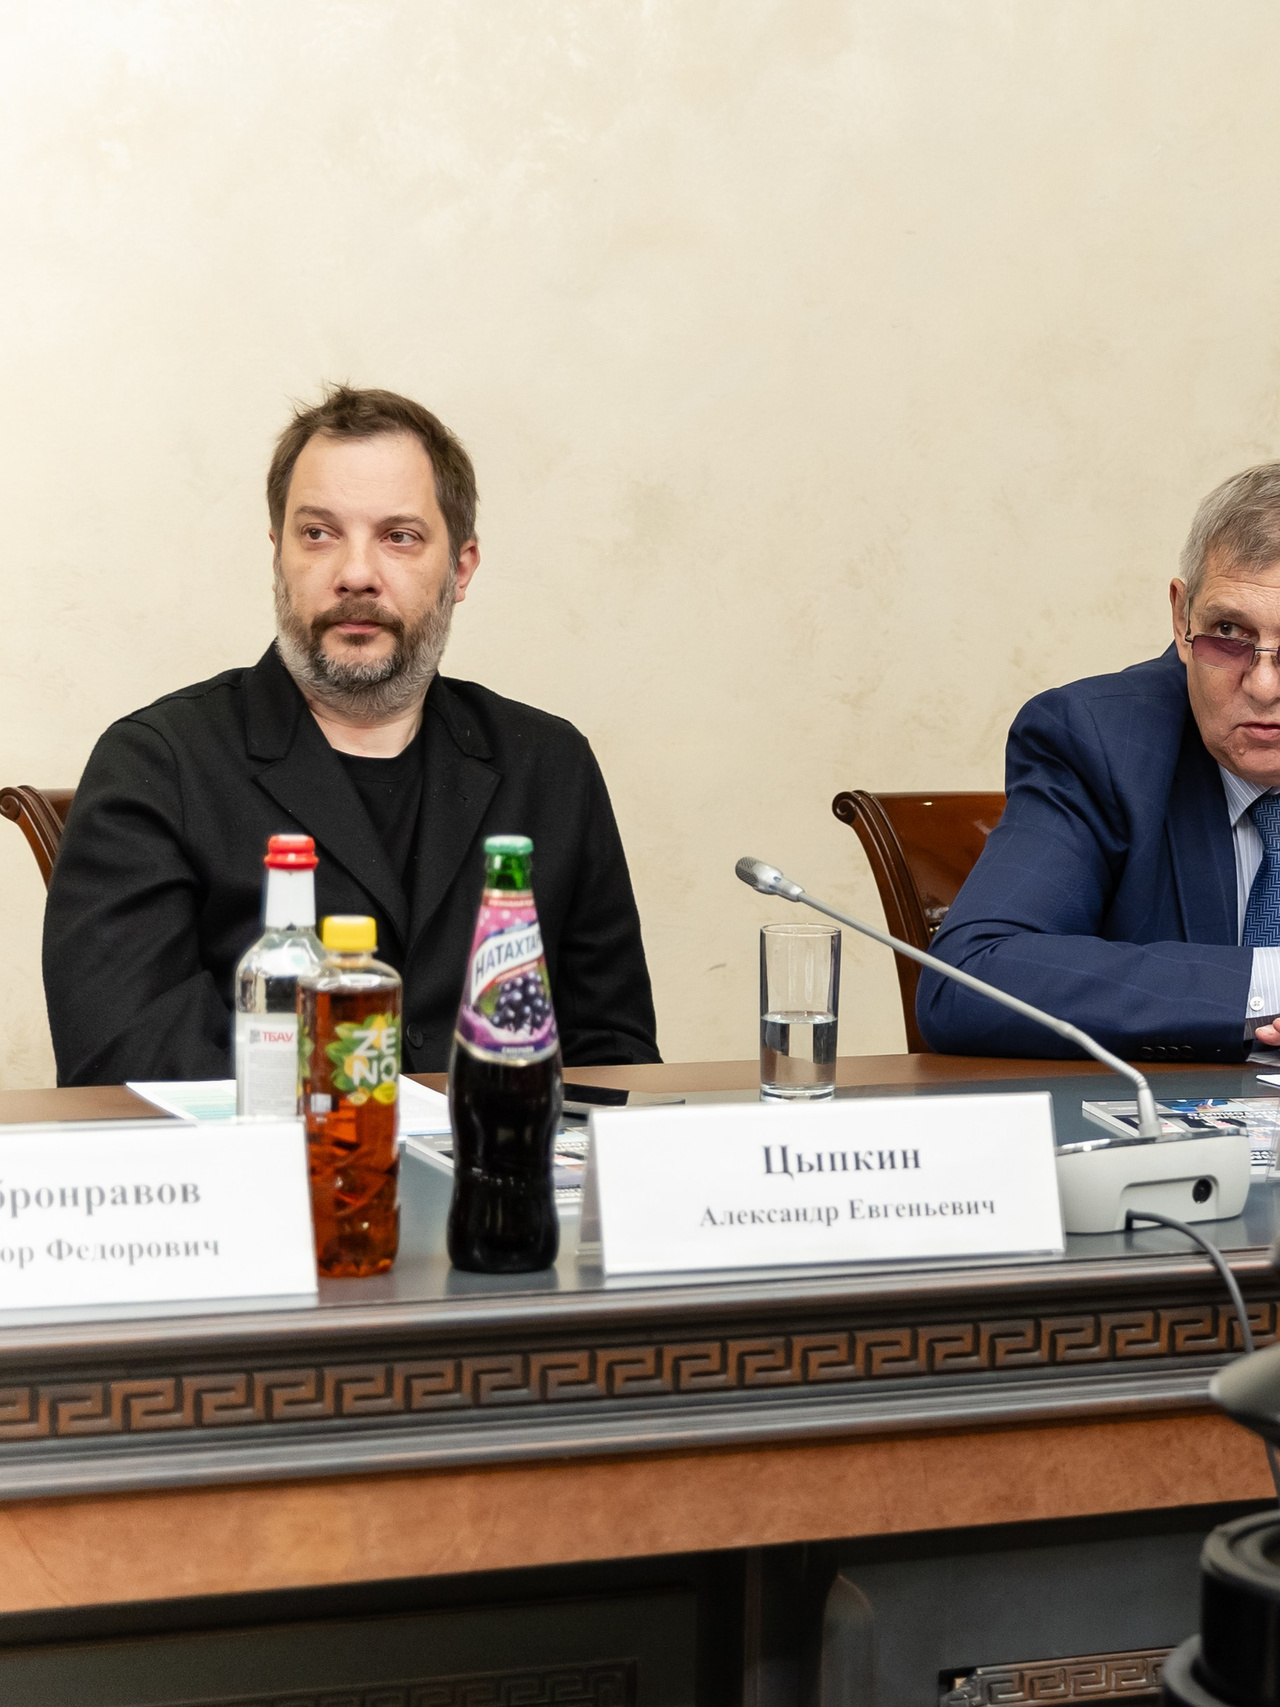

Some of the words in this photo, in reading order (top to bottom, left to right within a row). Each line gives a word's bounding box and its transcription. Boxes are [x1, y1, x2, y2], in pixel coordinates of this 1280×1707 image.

[263, 1031, 293, 1043] ТБАУ
[762, 1144, 922, 1180] Цыпкин
[699, 1205, 839, 1227] Александр
[849, 1197, 996, 1220] Евгеньевич
[46, 1238, 219, 1266] Федорович
